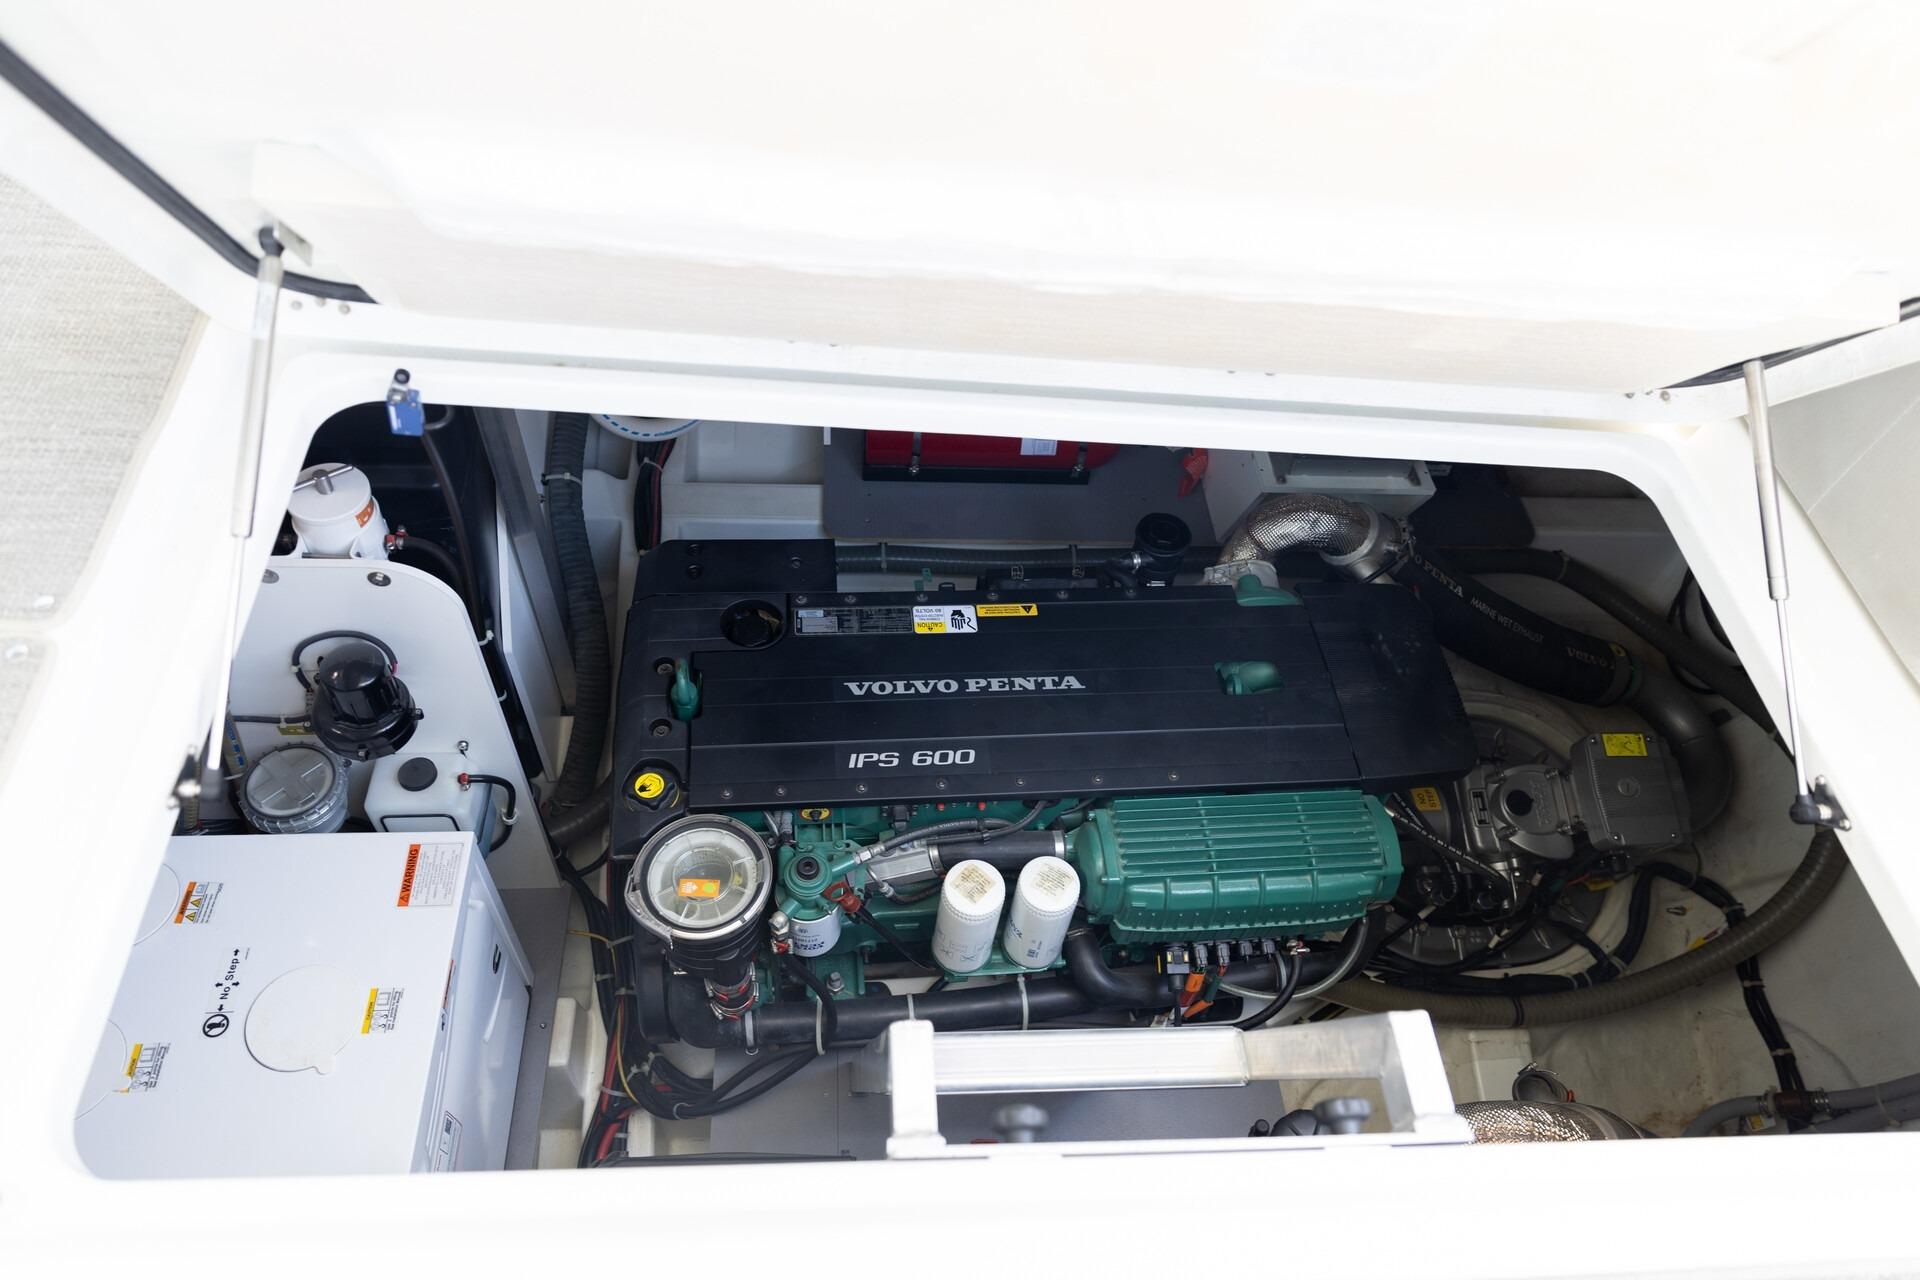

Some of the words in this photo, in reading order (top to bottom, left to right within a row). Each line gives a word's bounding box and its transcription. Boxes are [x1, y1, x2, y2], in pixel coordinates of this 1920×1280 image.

[1422, 558, 1465, 599] PENTA
[1496, 614, 1513, 629] WET
[843, 679, 960, 696] VOLVO
[965, 676, 1086, 693] PENTA
[848, 751, 901, 769] IPS
[911, 749, 976, 766] 600
[401, 848, 418, 893] WARNING
[224, 958, 241, 981] Step
[219, 986, 231, 1000] No
